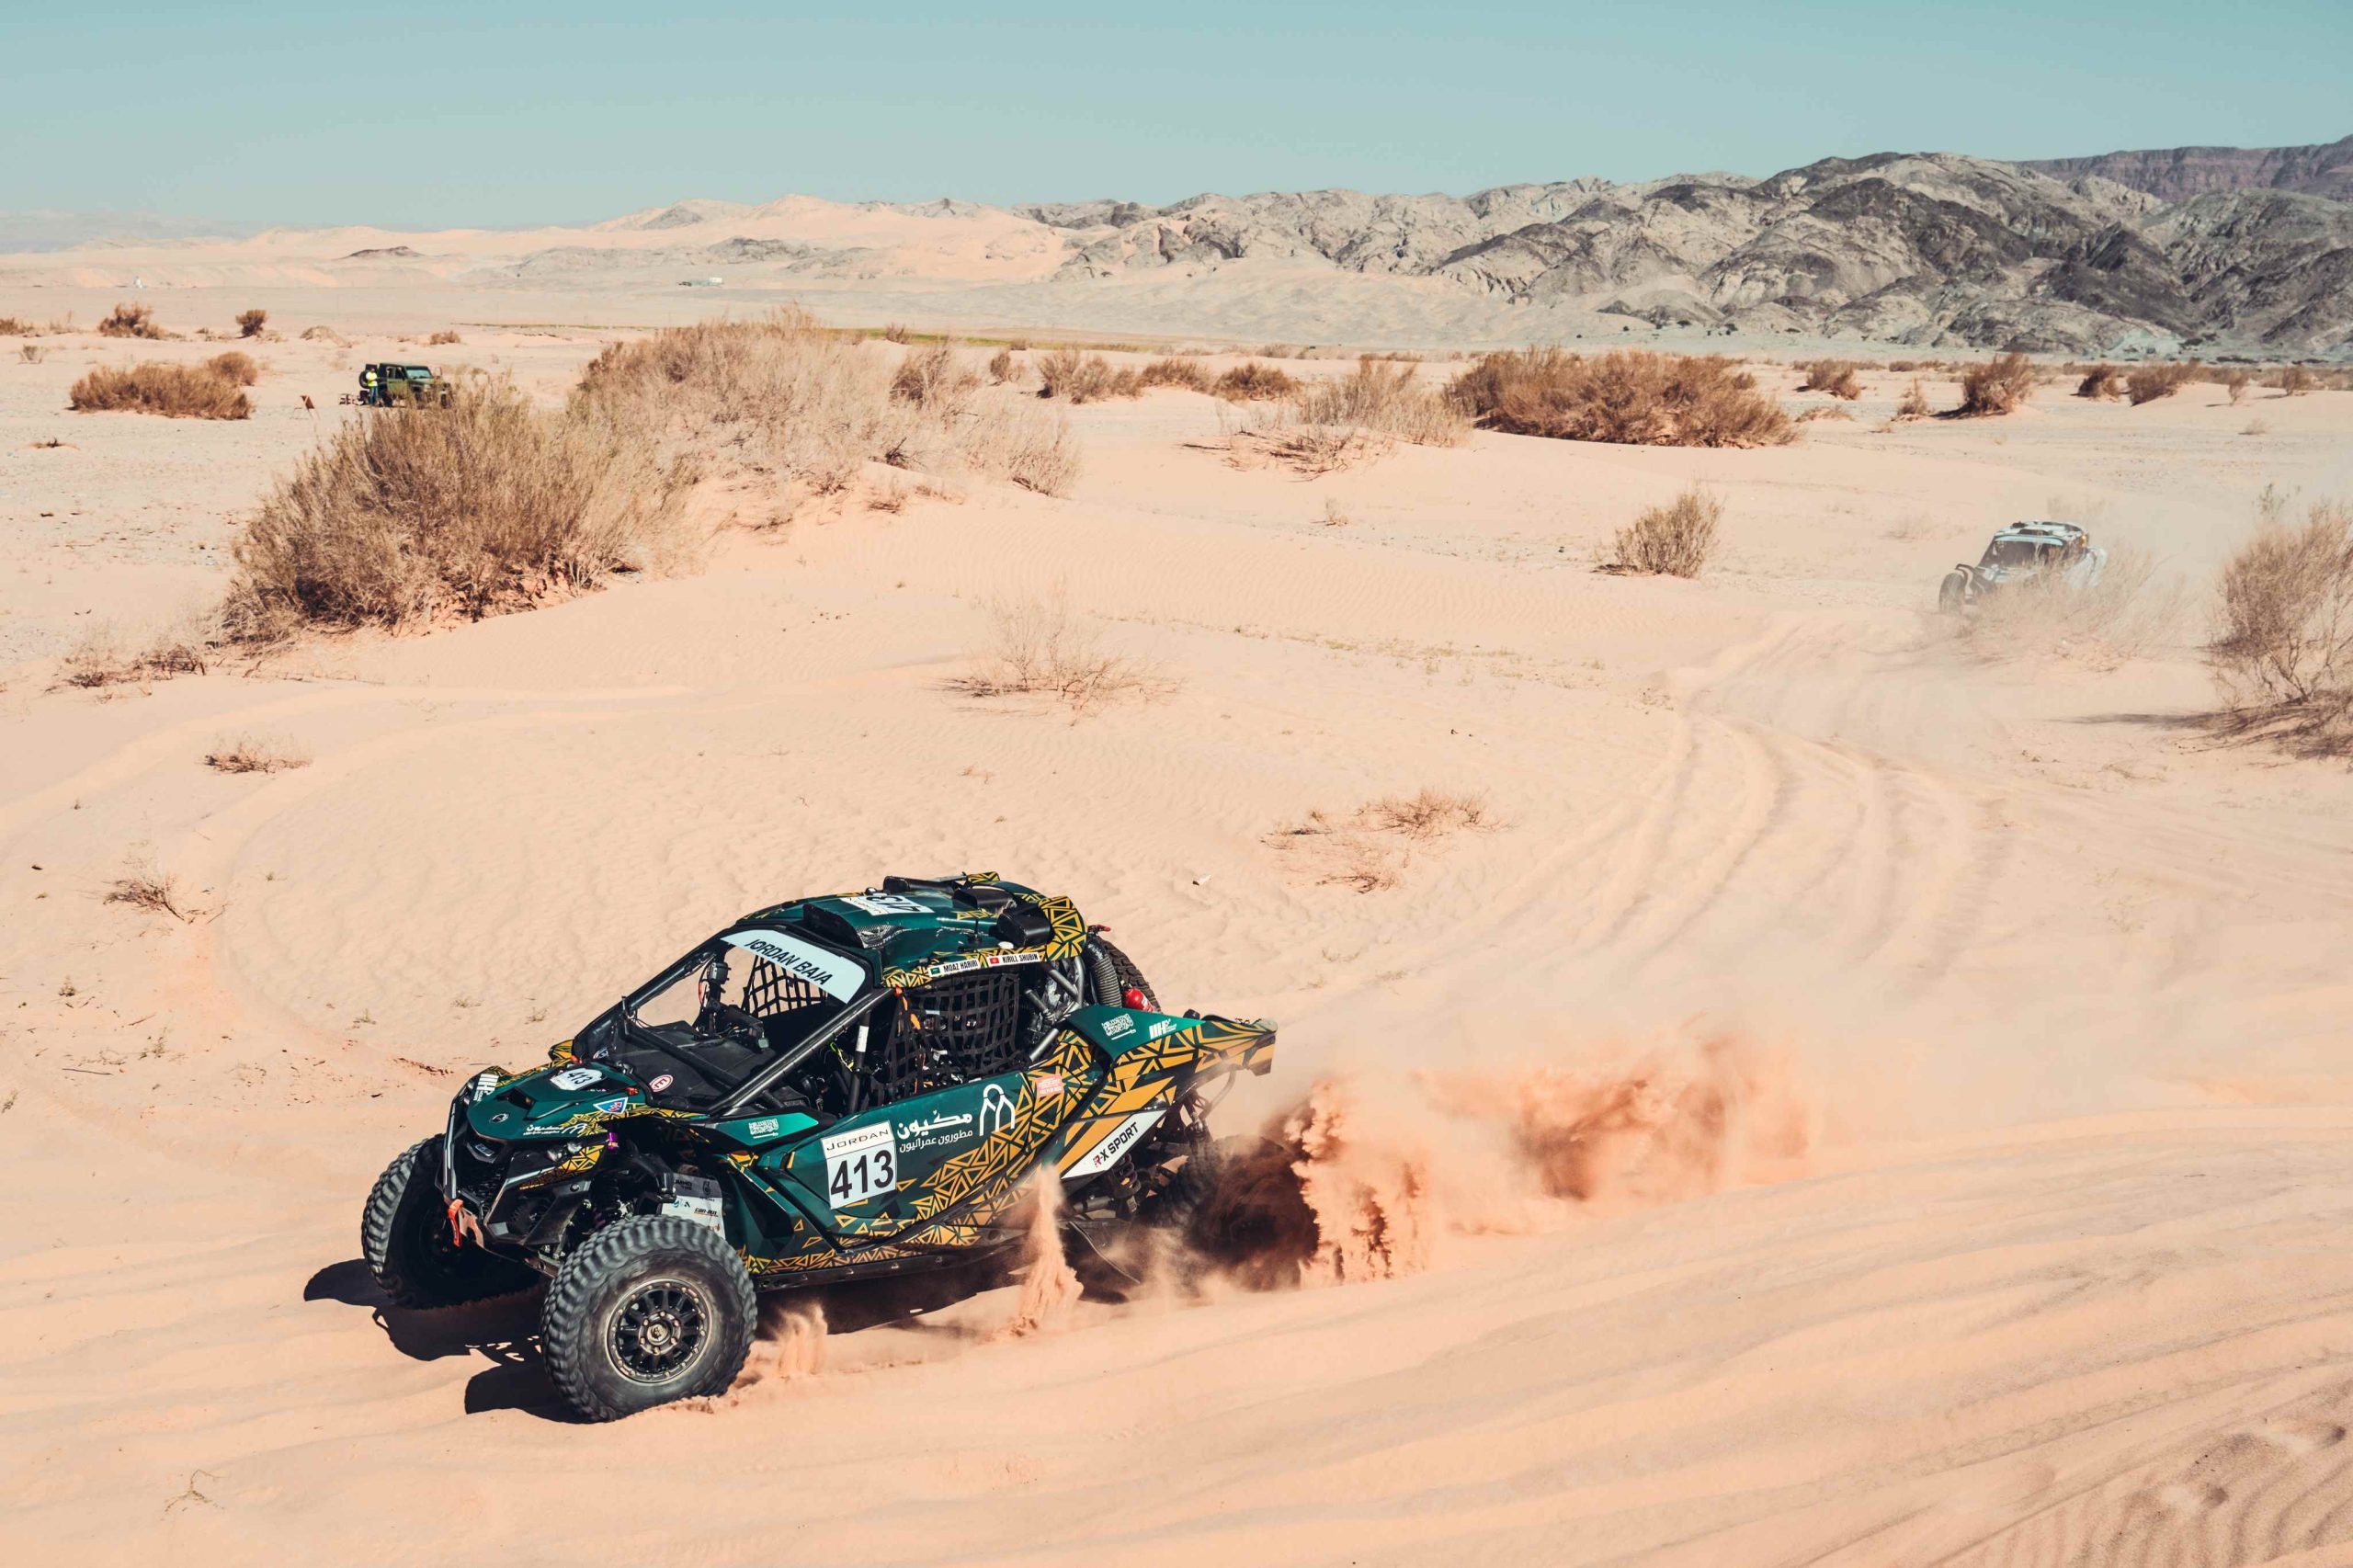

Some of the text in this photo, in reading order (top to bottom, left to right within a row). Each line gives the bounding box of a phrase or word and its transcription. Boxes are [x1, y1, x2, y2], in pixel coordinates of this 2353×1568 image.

[744, 938, 833, 985] JORDAN BAJA
[943, 963, 959, 972] MOAZ
[1002, 955, 1018, 963] KIRILL
[567, 1072, 592, 1085] 413
[826, 1129, 889, 1151] JORDAN
[899, 1130, 973, 1153] مطورون عمرانيون
[1093, 1121, 1139, 1168] R-X SPORT
[830, 1149, 894, 1199] 413
